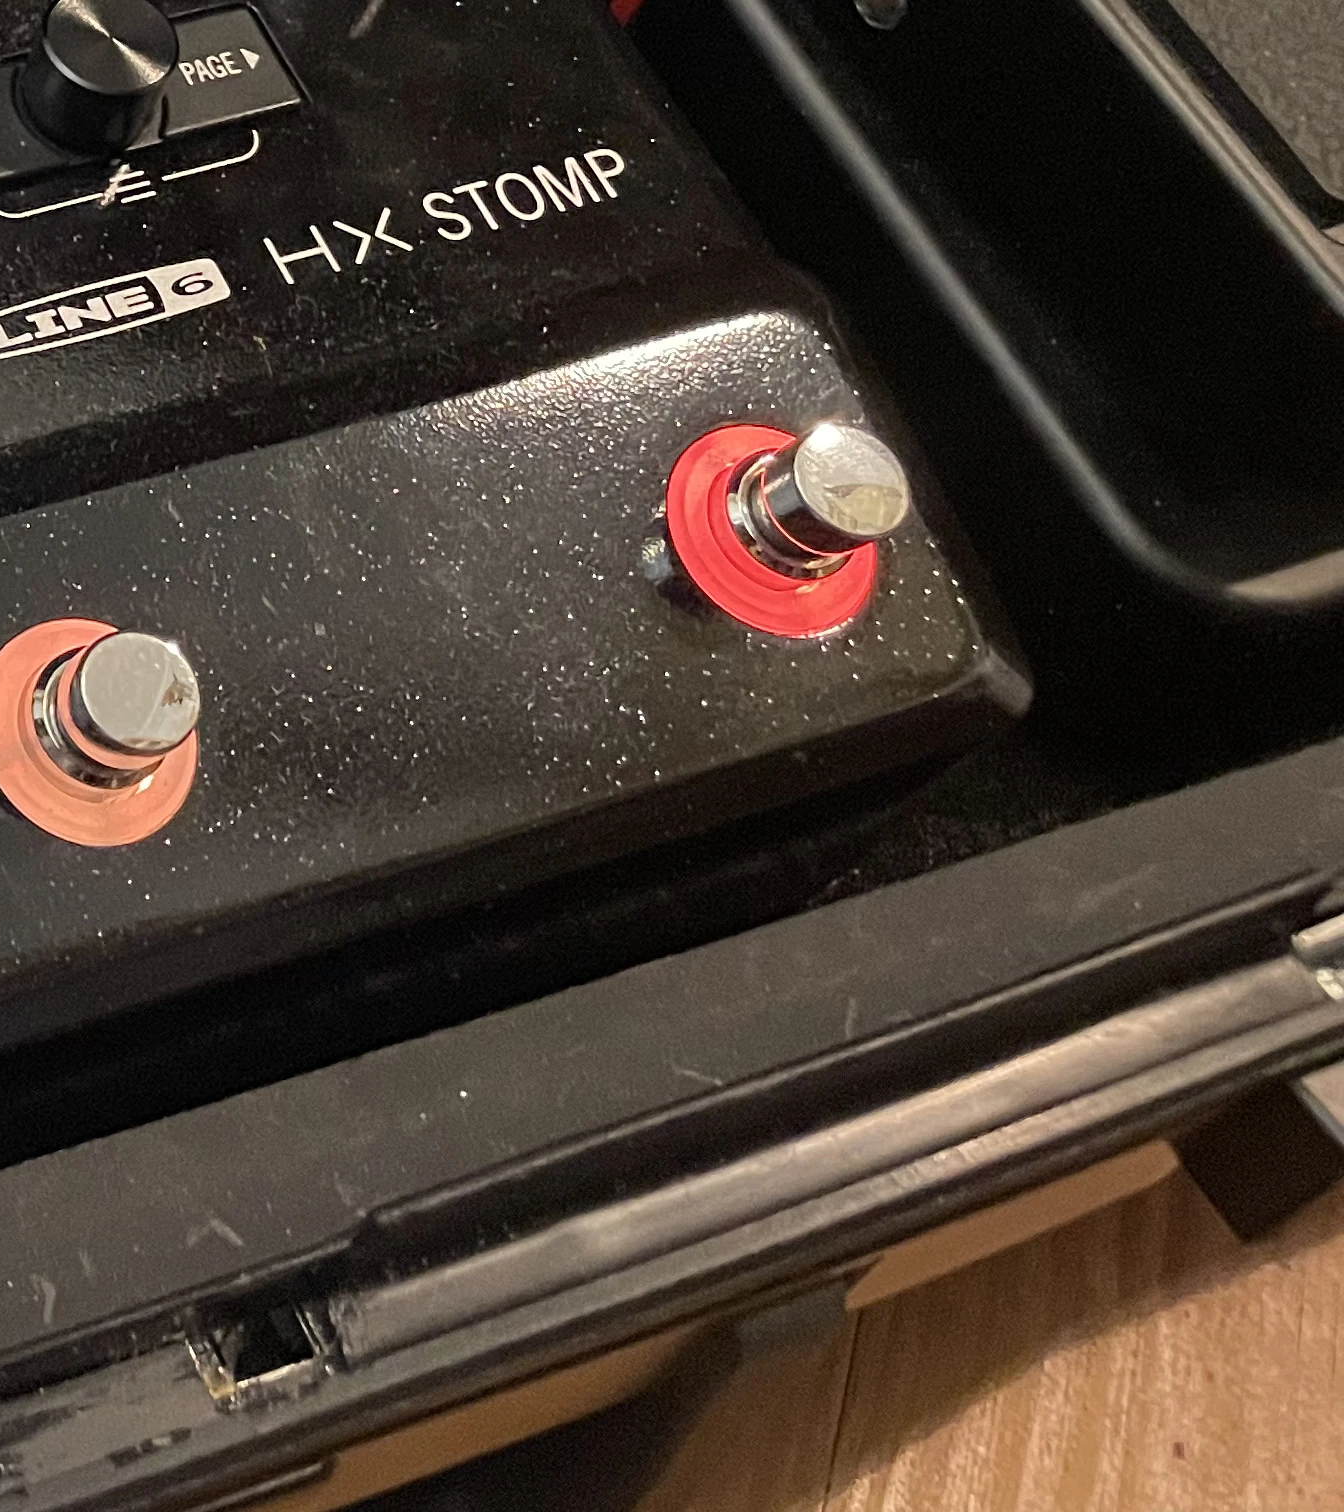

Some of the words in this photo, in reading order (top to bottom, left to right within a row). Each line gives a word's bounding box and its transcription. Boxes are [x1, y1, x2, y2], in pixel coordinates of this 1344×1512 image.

[178, 52, 242, 86] PAGE
[263, 209, 413, 285] HX
[422, 148, 626, 243] STOMP
[170, 271, 214, 296] 6
